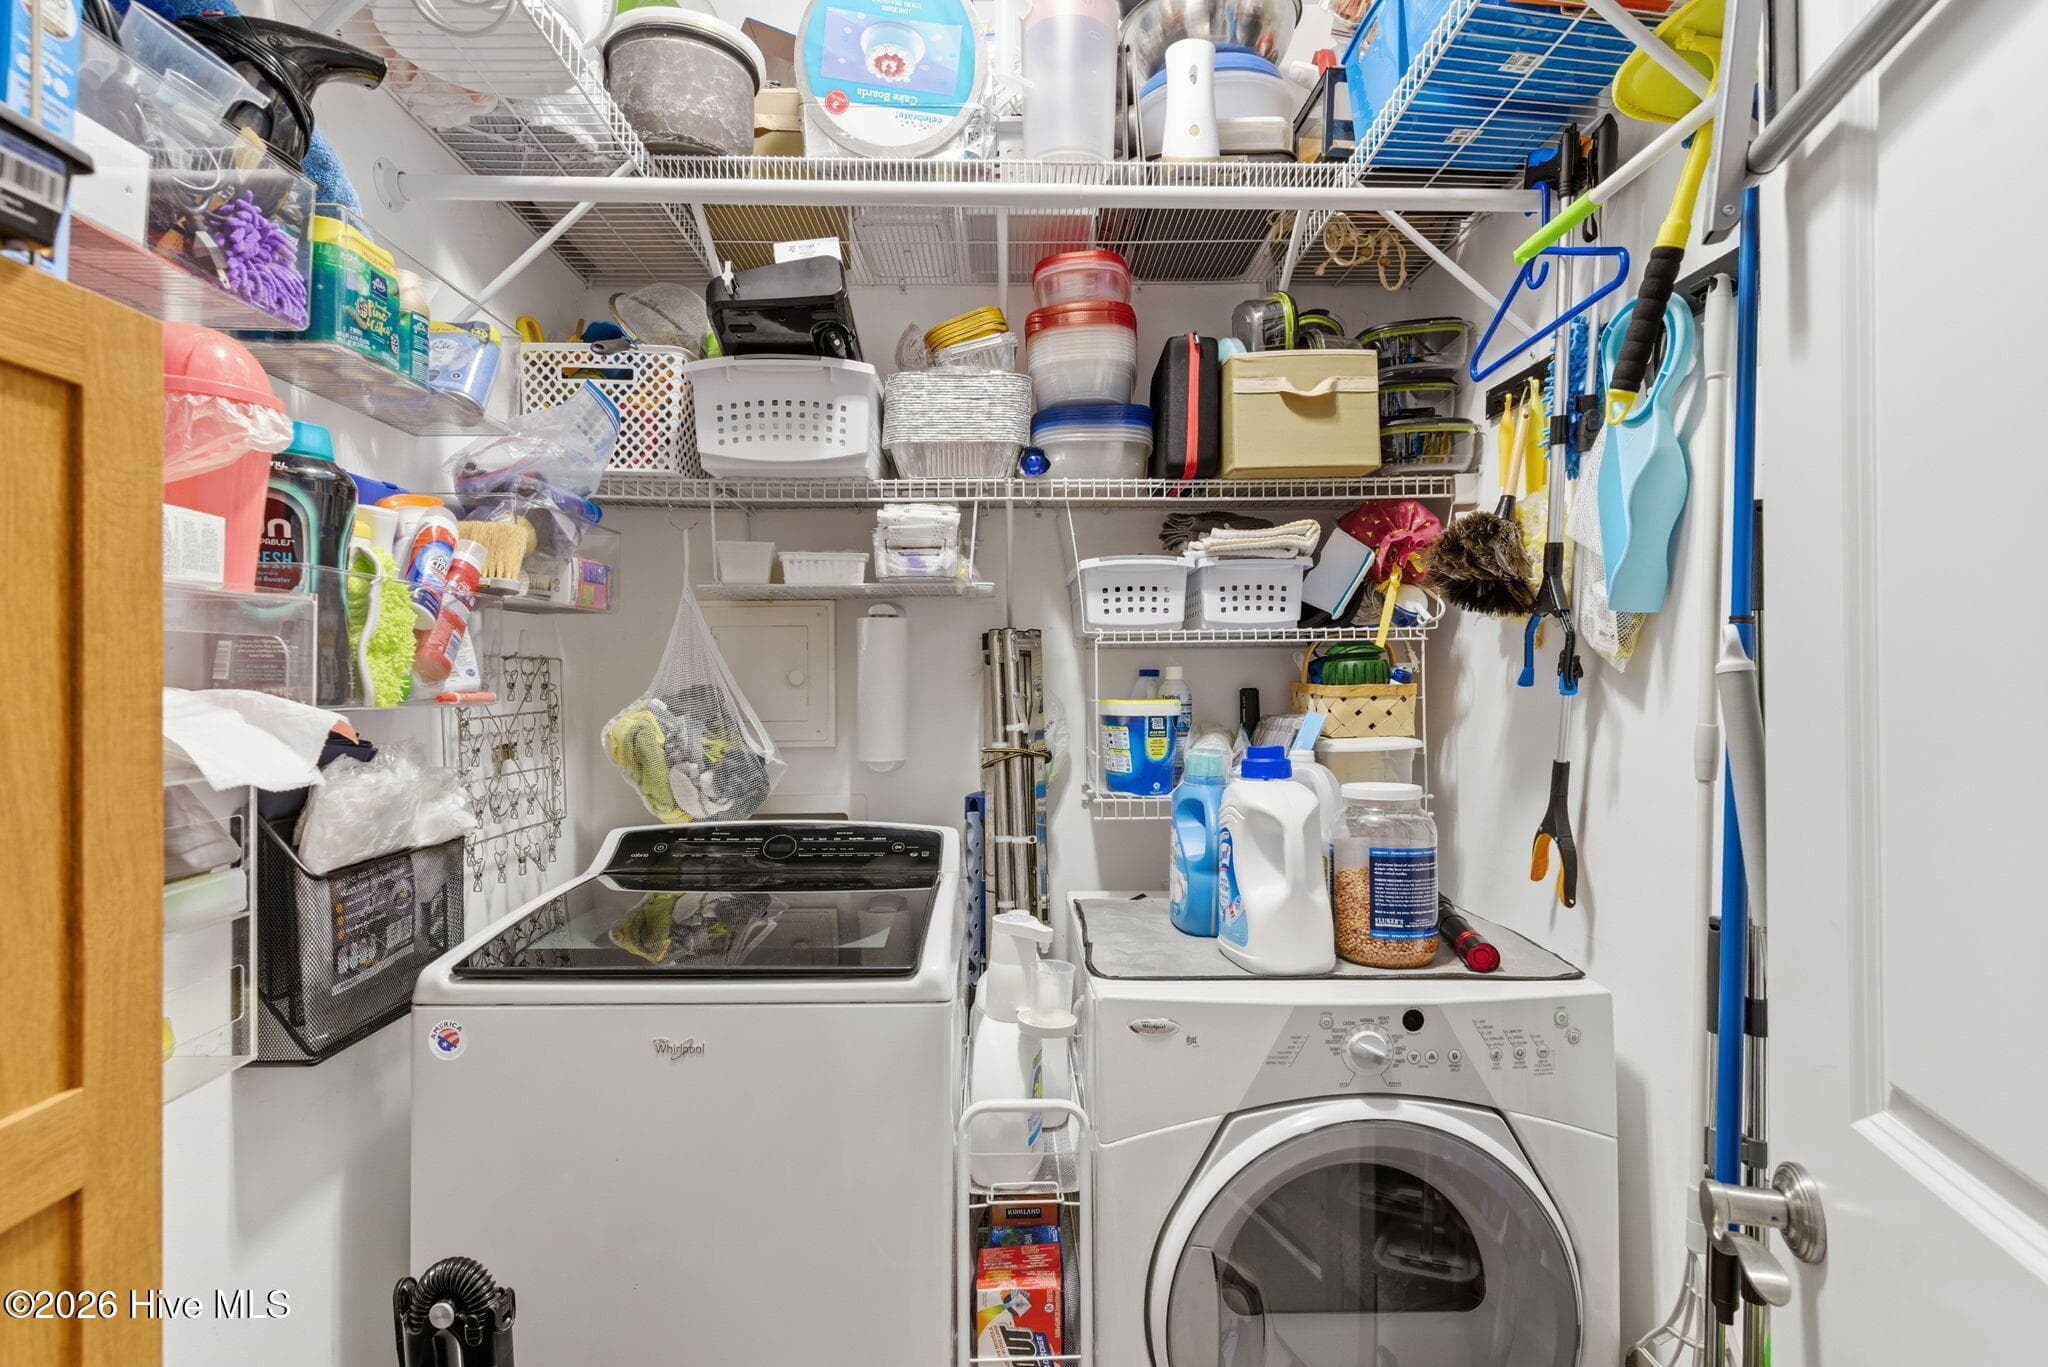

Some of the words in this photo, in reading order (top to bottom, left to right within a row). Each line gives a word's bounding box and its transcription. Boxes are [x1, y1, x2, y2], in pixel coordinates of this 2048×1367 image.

[856, 87, 890, 102] Boards
[894, 92, 919, 106] Cake
[895, 111, 943, 124] celebrate!
[430, 1021, 462, 1040] AMERICA
[655, 1041, 705, 1058] Whirlpool
